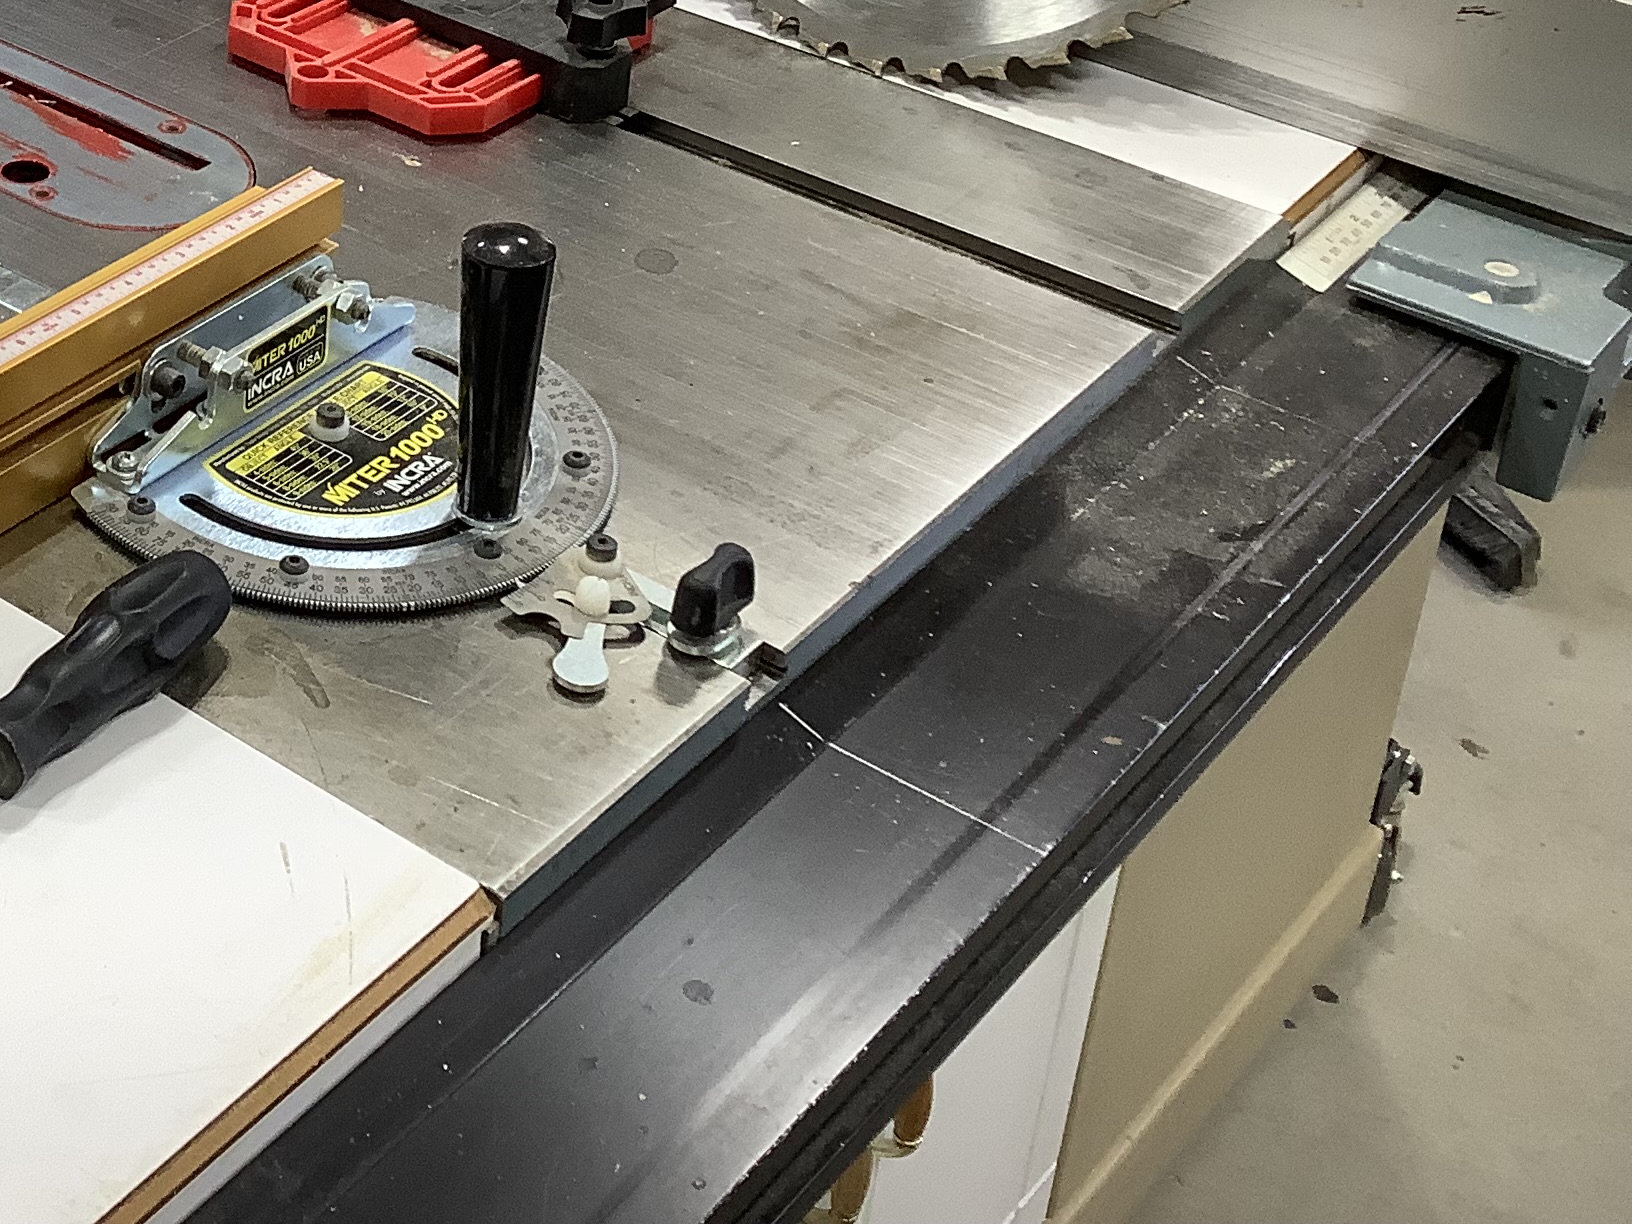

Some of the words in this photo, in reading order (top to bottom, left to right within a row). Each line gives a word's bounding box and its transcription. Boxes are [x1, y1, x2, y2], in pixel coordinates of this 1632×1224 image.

[299, 351, 321, 371] USA
[247, 361, 294, 401] INCRA
[322, 456, 400, 506] MITER
[382, 454, 445, 493] INCRA
[401, 461, 453, 497] www.incra.com
